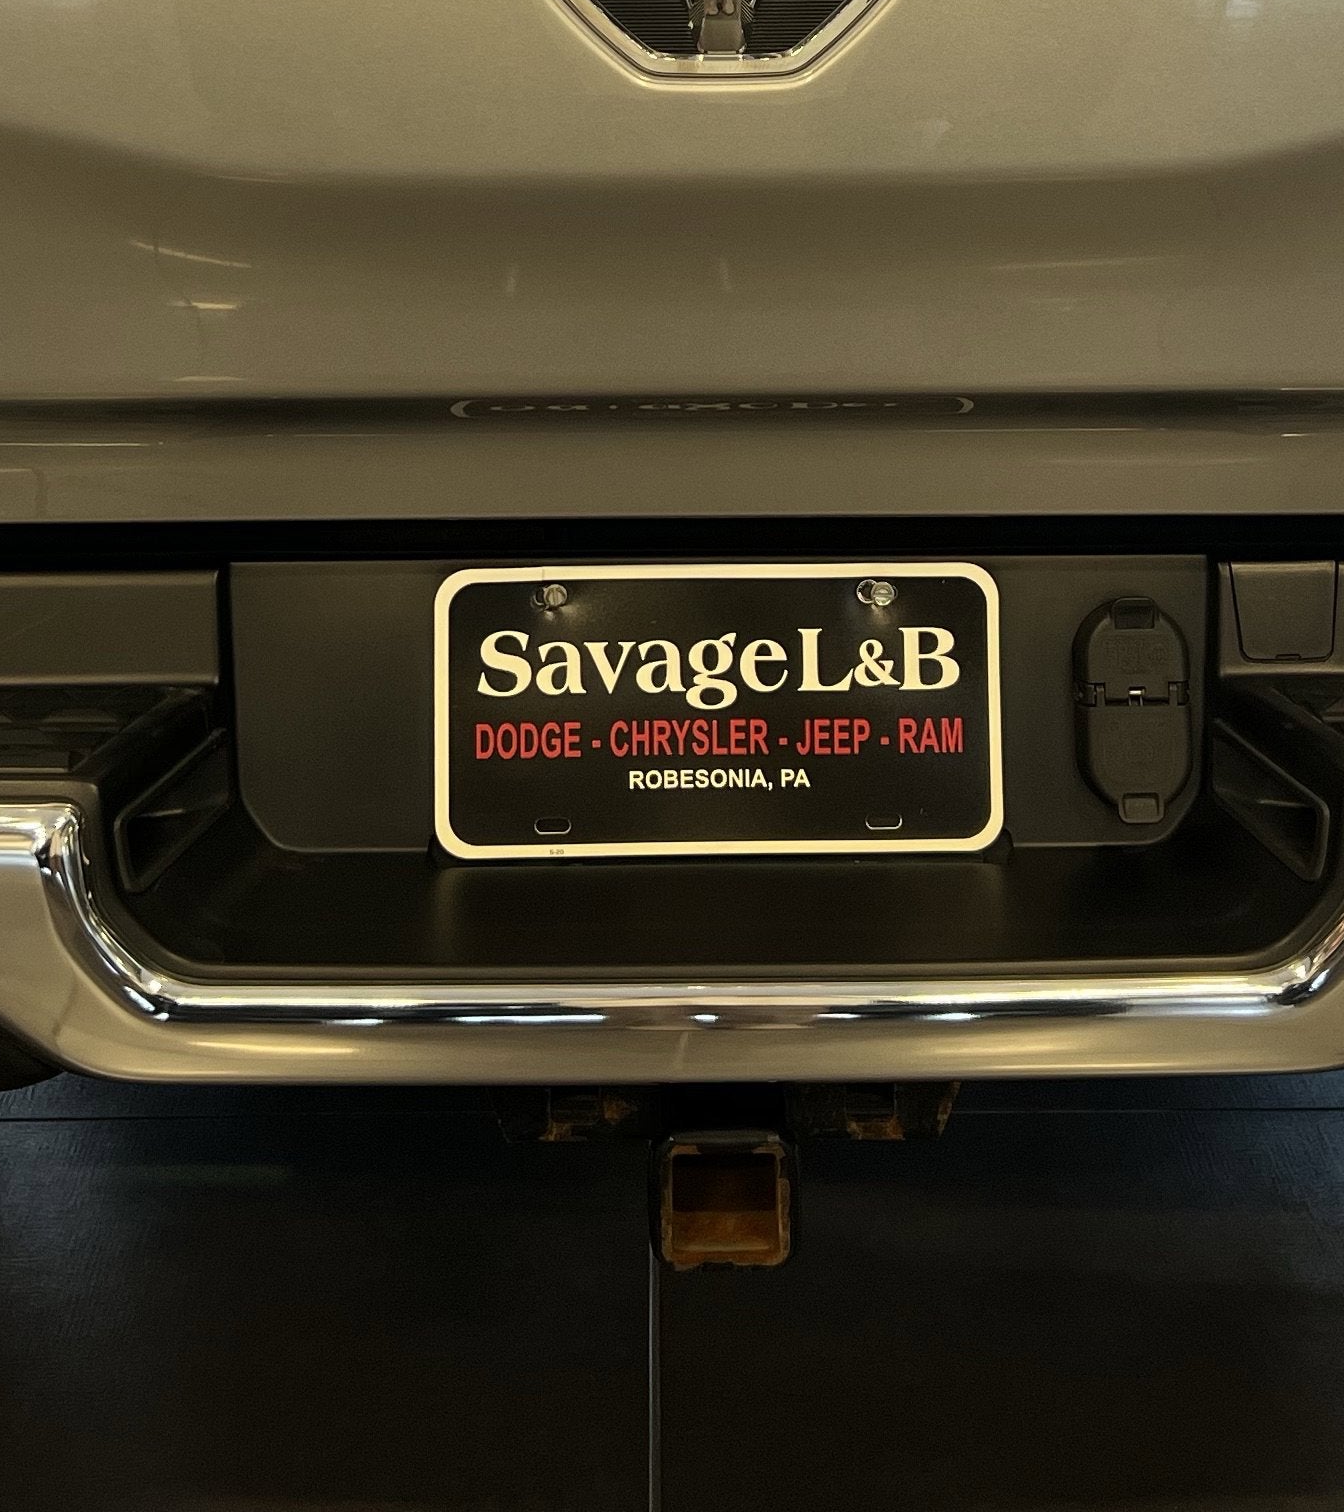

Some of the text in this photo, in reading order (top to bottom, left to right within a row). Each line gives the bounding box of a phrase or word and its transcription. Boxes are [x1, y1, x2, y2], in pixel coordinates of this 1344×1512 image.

[474, 721, 583, 760] DODGE
[609, 718, 770, 757] CHRYSLER
[795, 717, 872, 756] JEEP
[897, 717, 964, 754] RAM
[628, 768, 812, 792] ROBESONIA, PA
